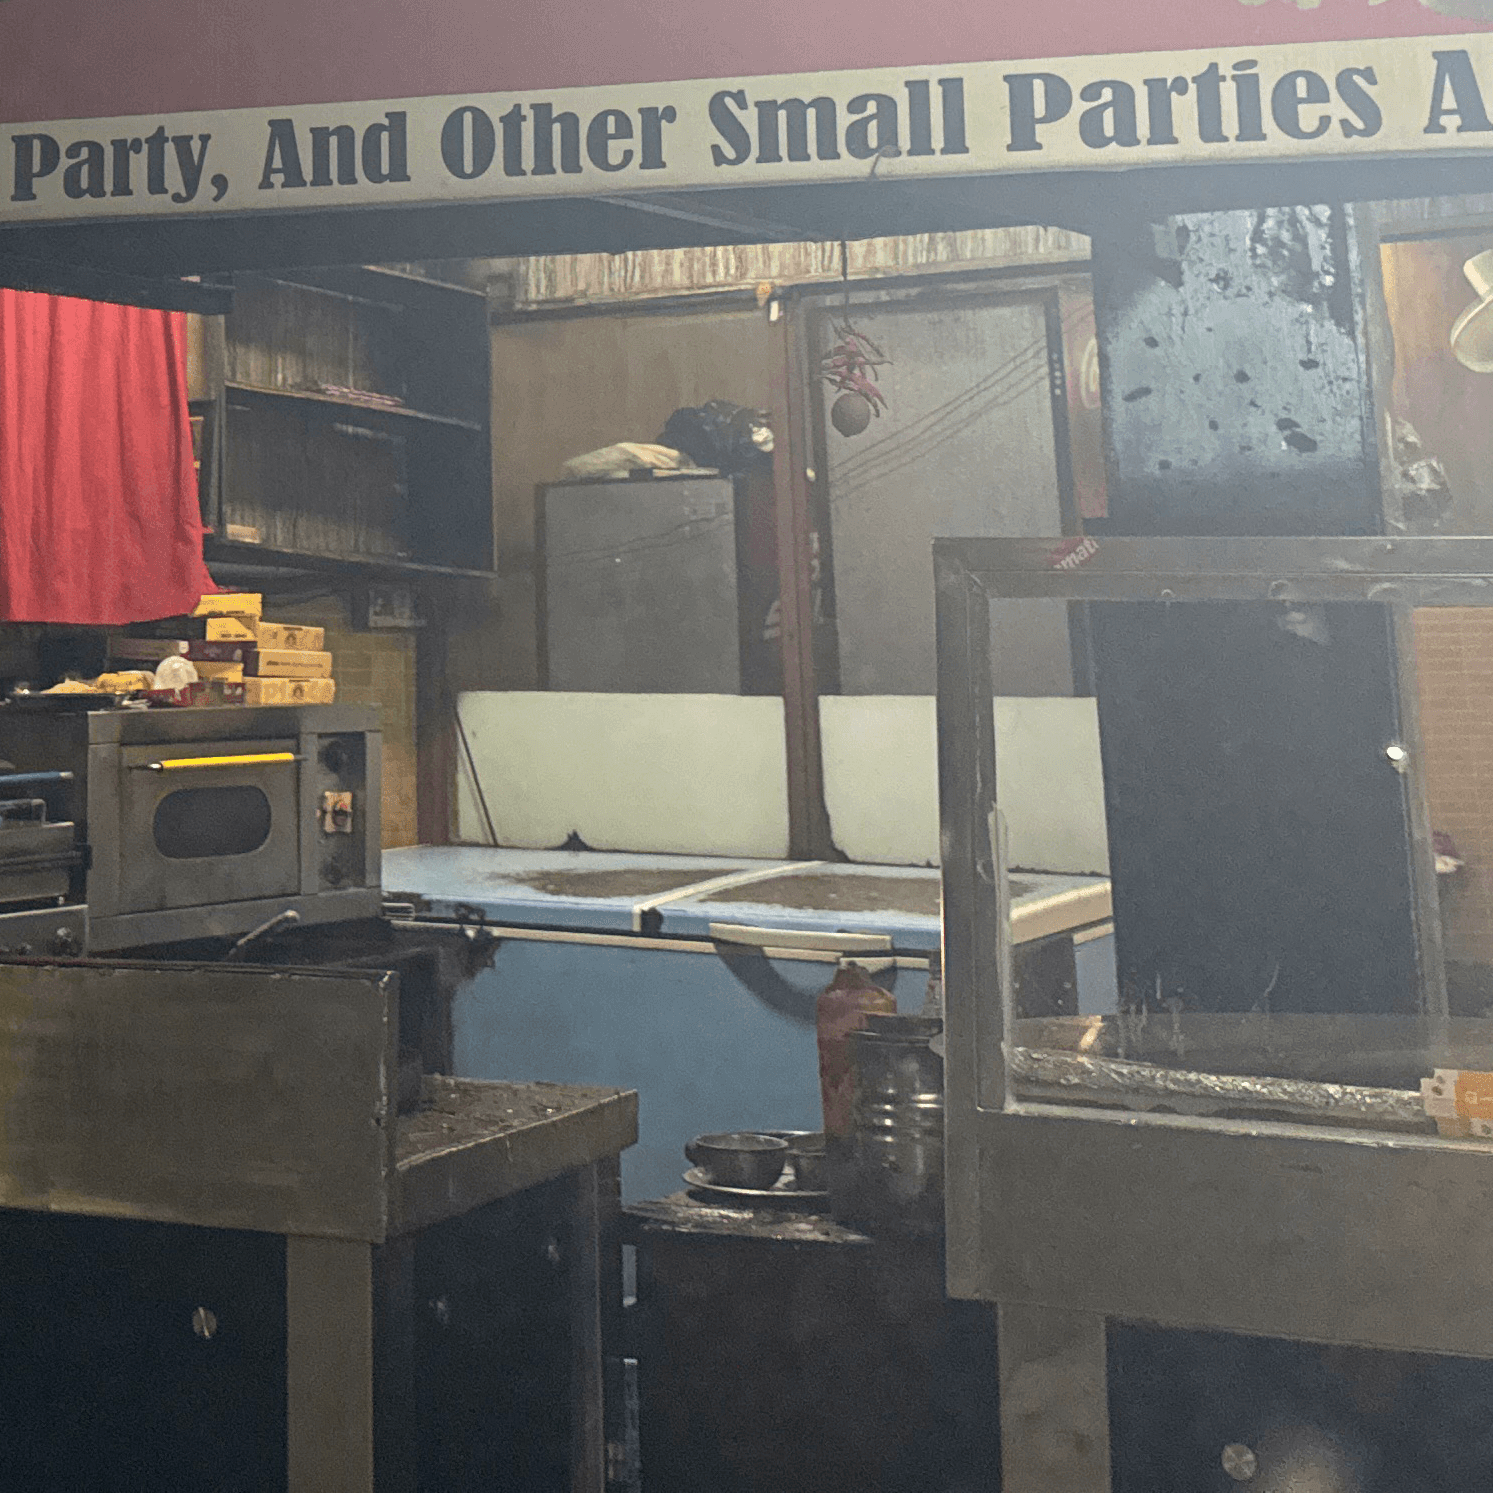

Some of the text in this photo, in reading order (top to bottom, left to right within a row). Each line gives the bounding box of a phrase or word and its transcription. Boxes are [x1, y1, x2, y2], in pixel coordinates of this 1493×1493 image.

[10, 125, 230, 206] Party,
[258, 110, 411, 190] And
[440, 103, 678, 181] Other
[708, 76, 969, 168] Small
[1002, 58, 1384, 153] Parties
[1423, 49, 1493, 134] A
